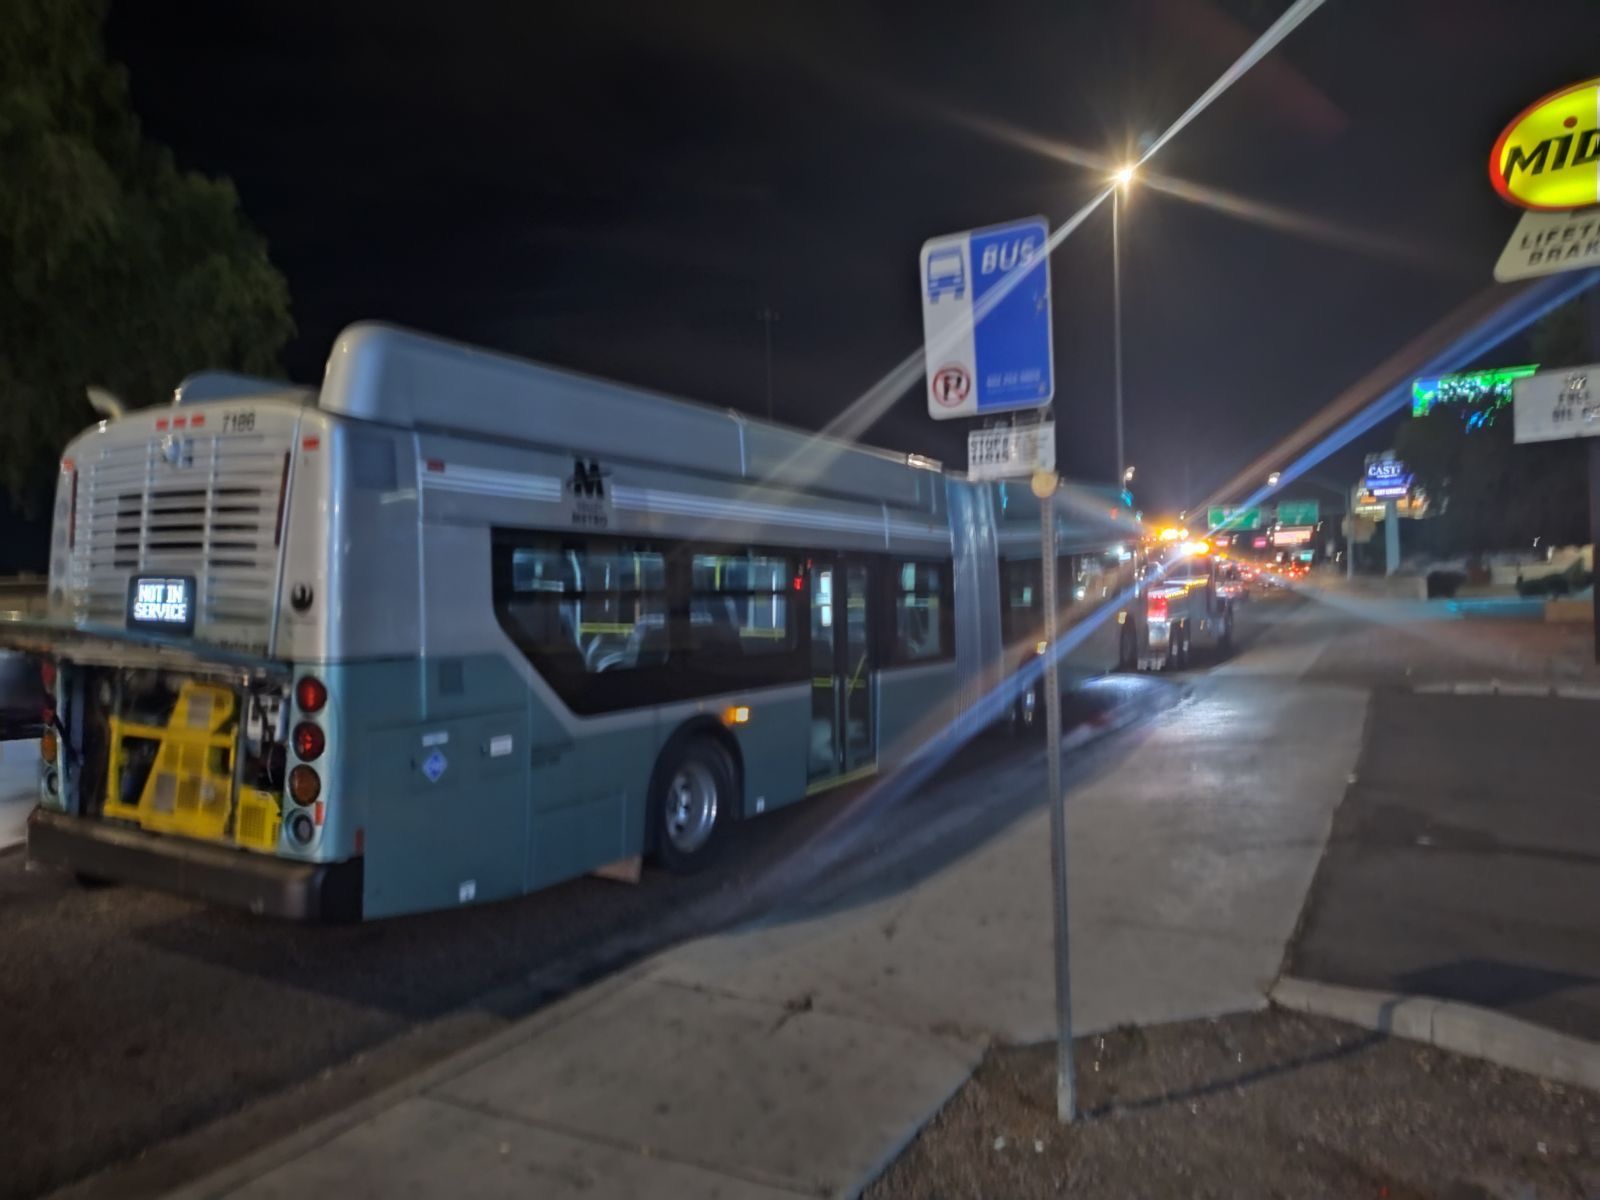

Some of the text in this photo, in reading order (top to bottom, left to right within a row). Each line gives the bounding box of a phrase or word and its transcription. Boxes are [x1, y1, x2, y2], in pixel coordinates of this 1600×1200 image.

[981, 235, 1035, 274] BUS
[970, 437, 1001, 453] STOP
[138, 580, 184, 603] NOT IN
[133, 602, 187, 623] SERVICE
